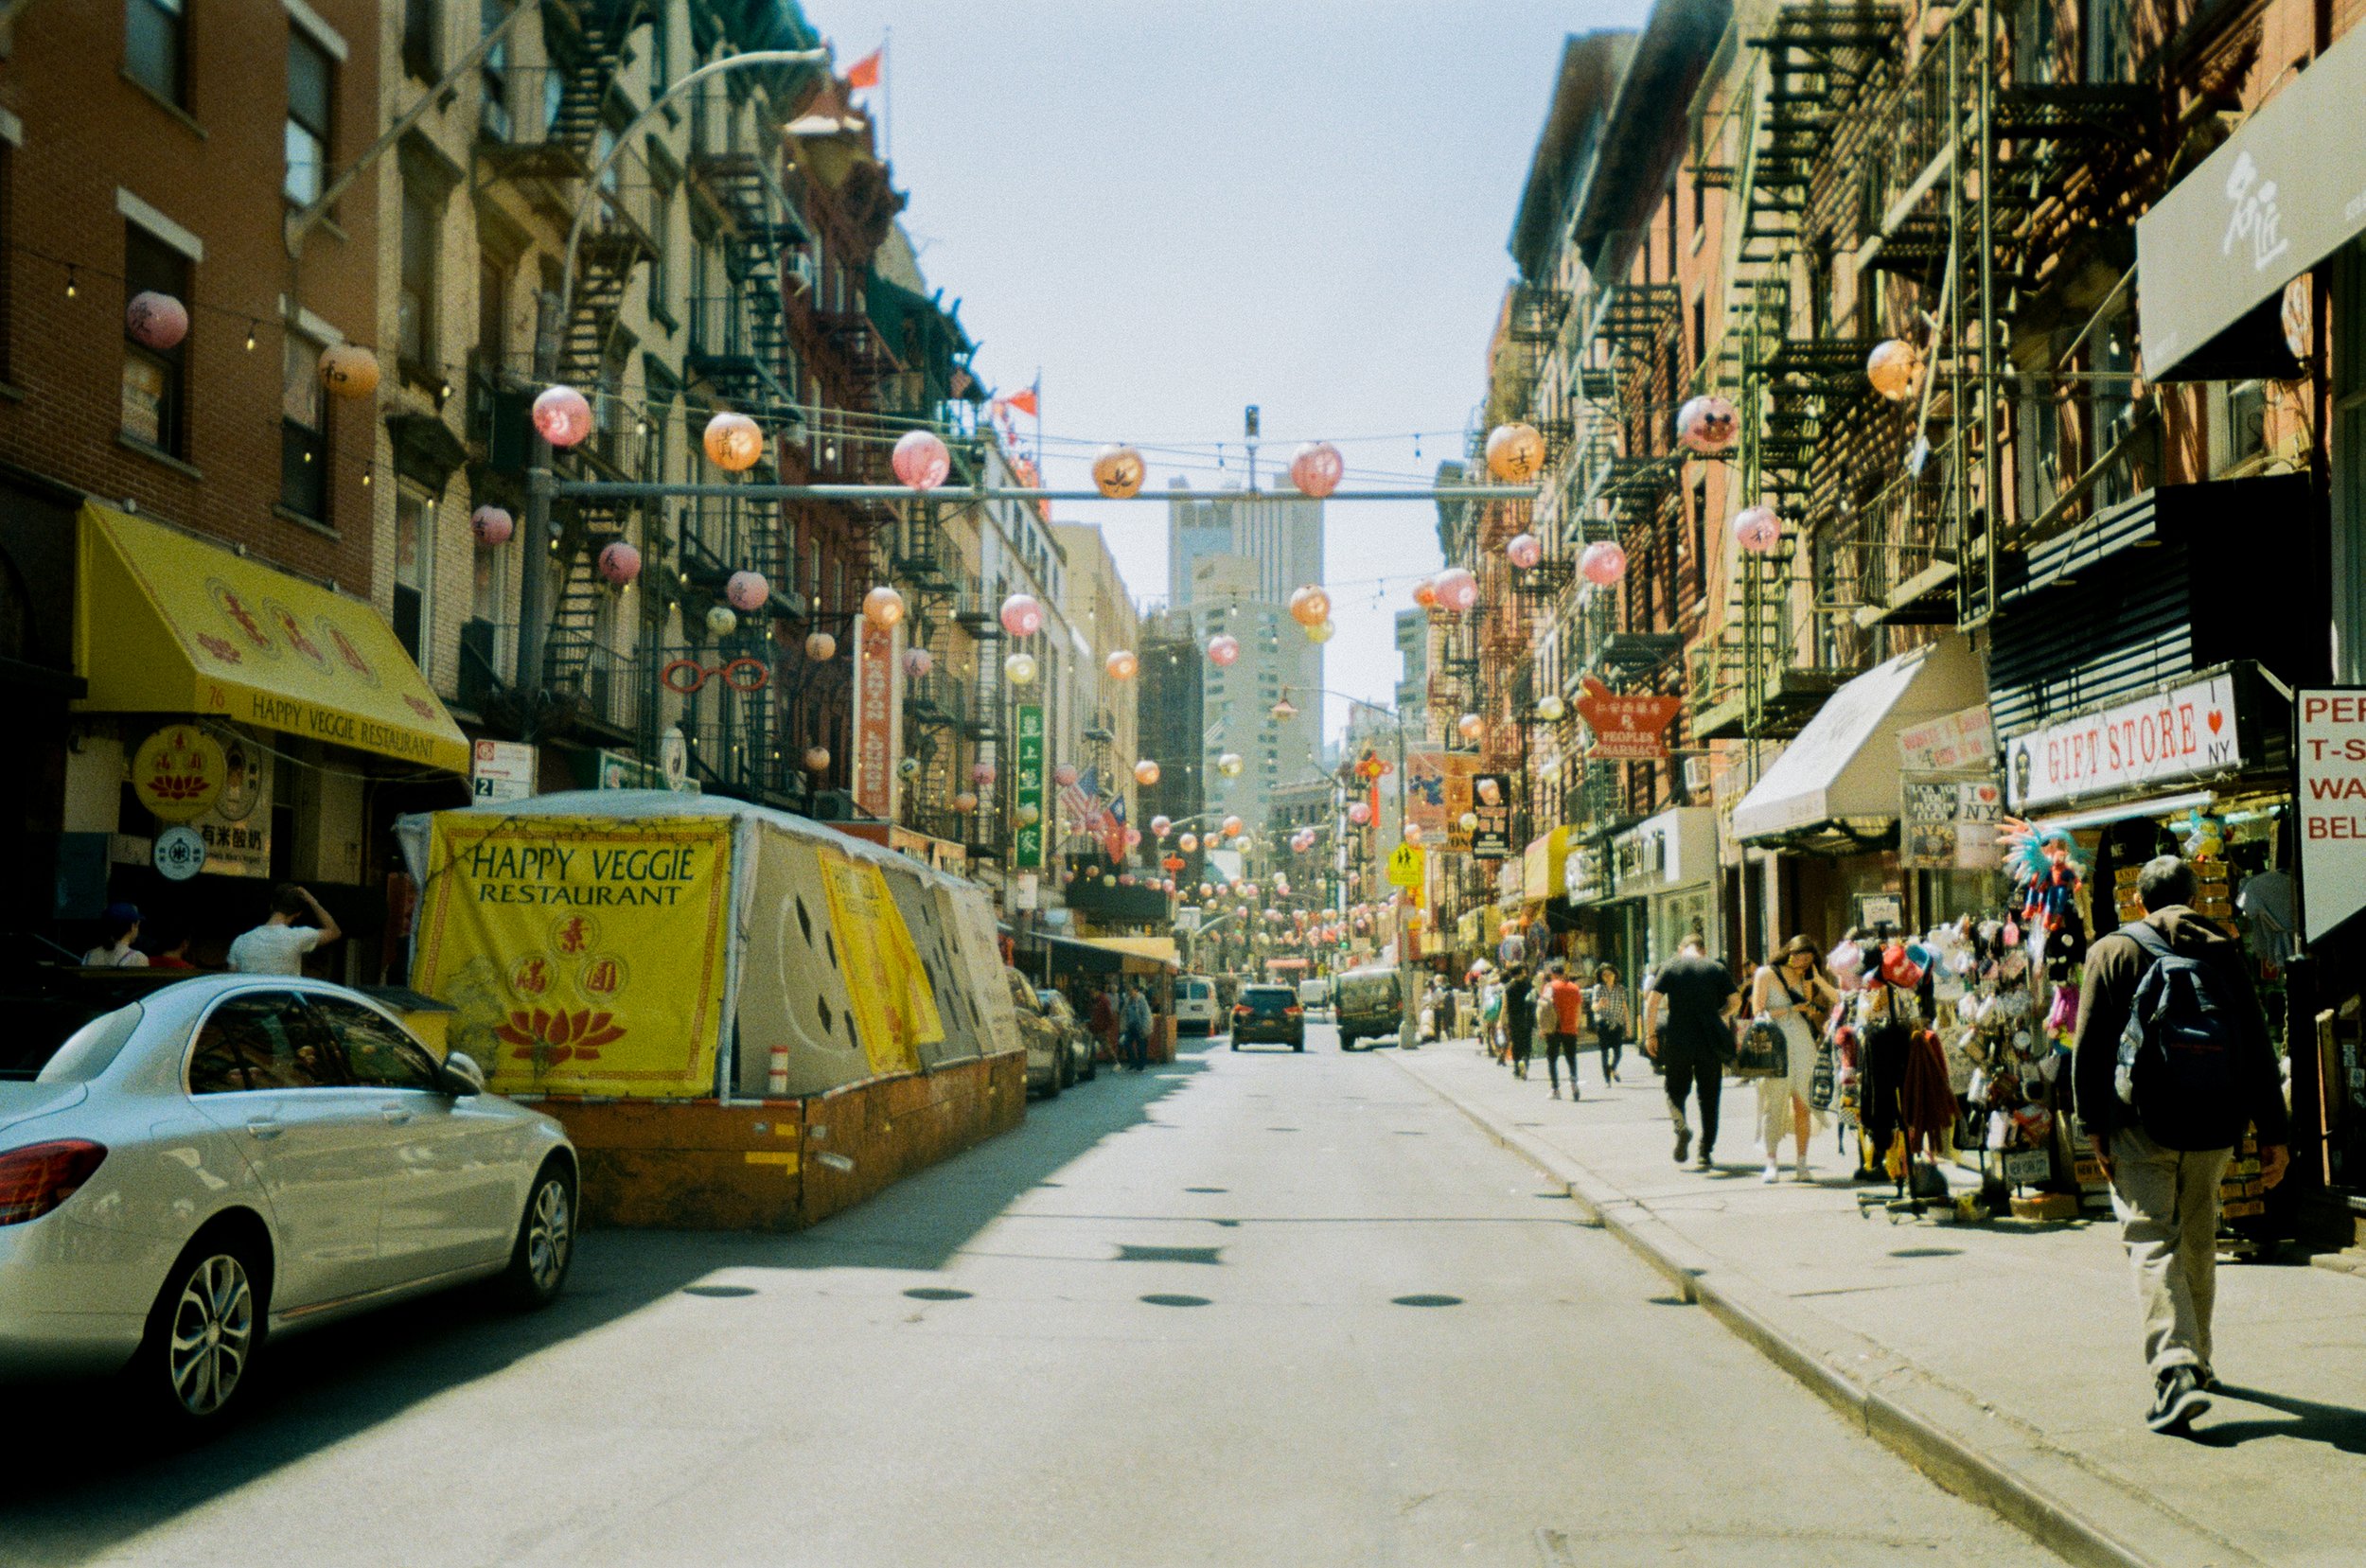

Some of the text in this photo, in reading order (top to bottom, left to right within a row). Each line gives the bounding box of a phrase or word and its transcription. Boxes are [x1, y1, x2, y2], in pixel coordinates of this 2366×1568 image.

[209, 685, 225, 708] 76
[2210, 680, 2216, 703] I
[253, 695, 435, 757] HAPPY VEGGIE RESTAURANT
[1597, 744, 1661, 756] PHARMACY
[2048, 730, 2099, 784] GIFT
[2108, 702, 2197, 770] STORE
[2208, 740, 2230, 766] NY
[479, 779, 489, 795] 2
[1968, 786, 1976, 802] I
[1964, 804, 2000, 820] NY
[2308, 817, 2366, 839] BEL
[471, 843, 696, 881] HAPPY VEGGIE
[479, 883, 682, 906] RESTAURANT
